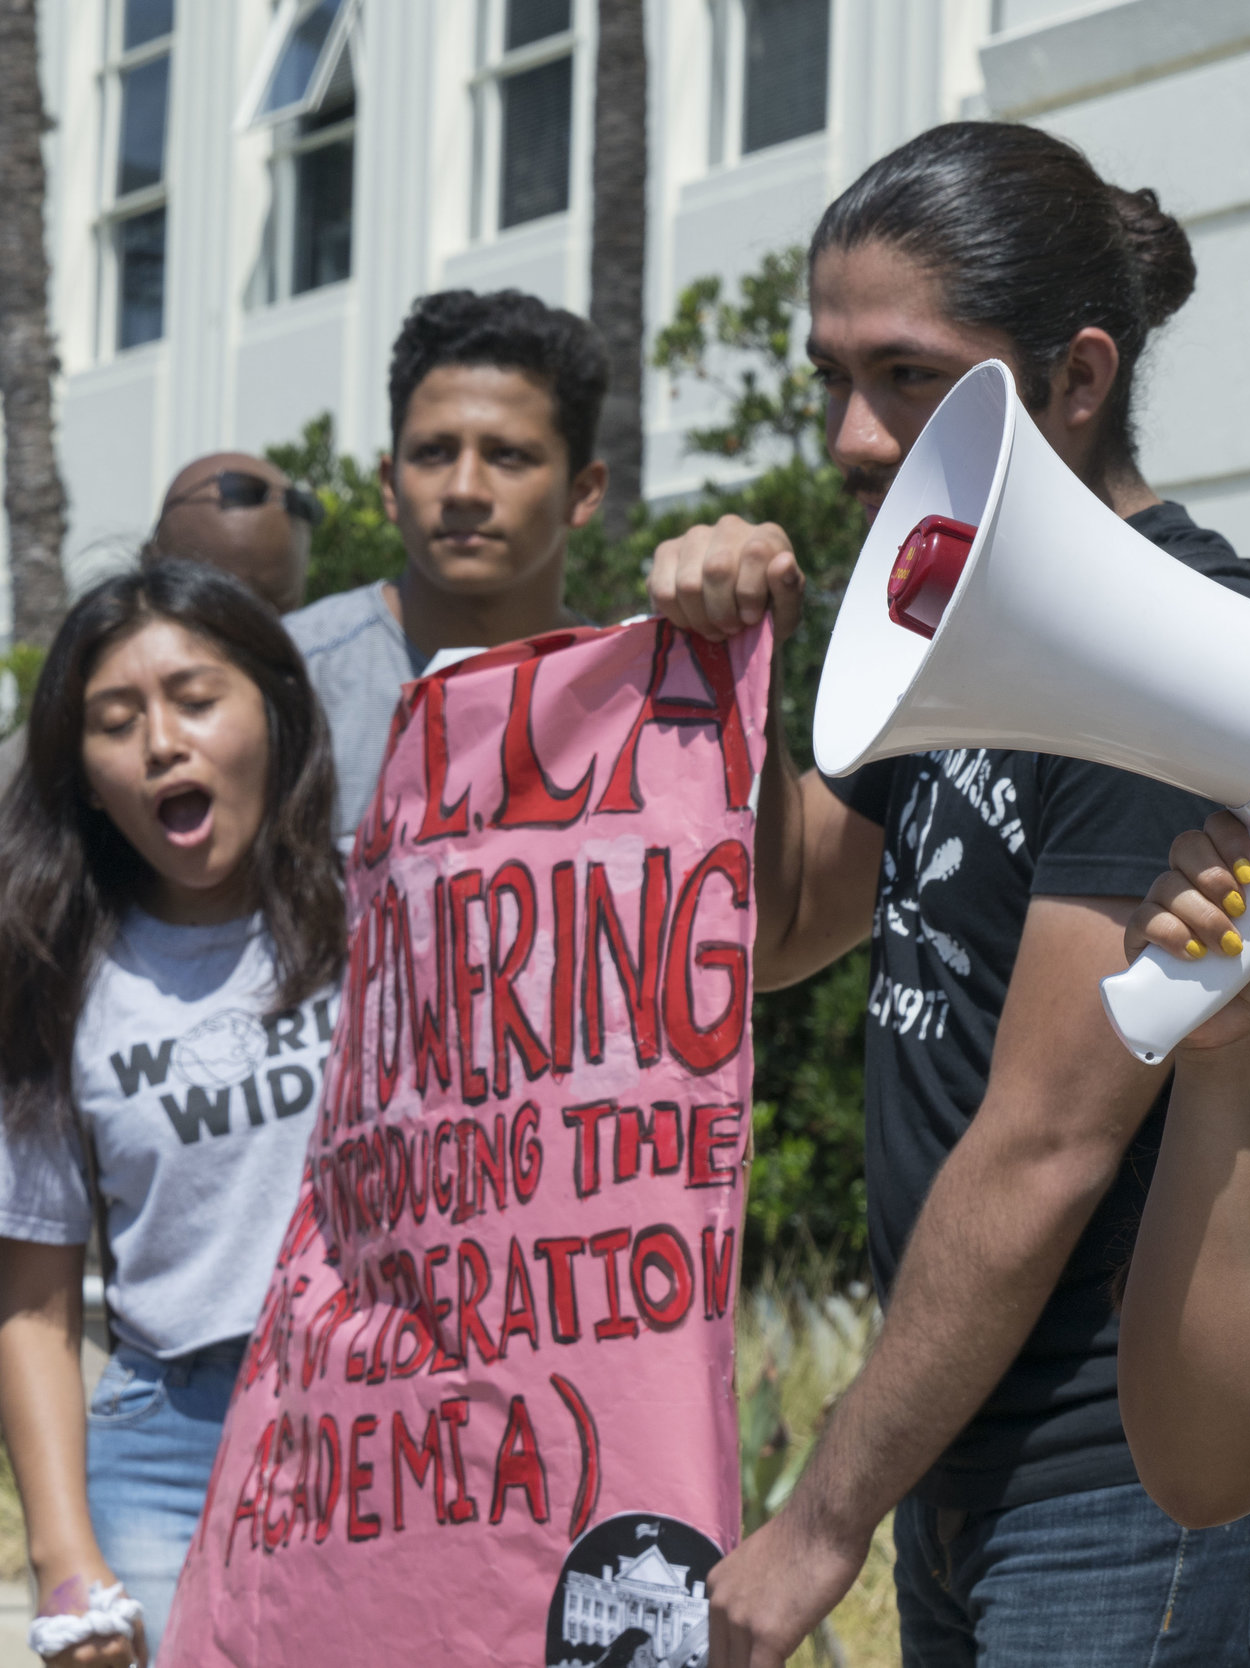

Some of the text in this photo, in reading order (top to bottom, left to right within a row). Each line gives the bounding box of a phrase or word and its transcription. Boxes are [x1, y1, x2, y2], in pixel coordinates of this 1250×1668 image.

[110, 999, 338, 1098] WORL
[160, 1056, 334, 1145] WID
[563, 1100, 744, 1200] THE
